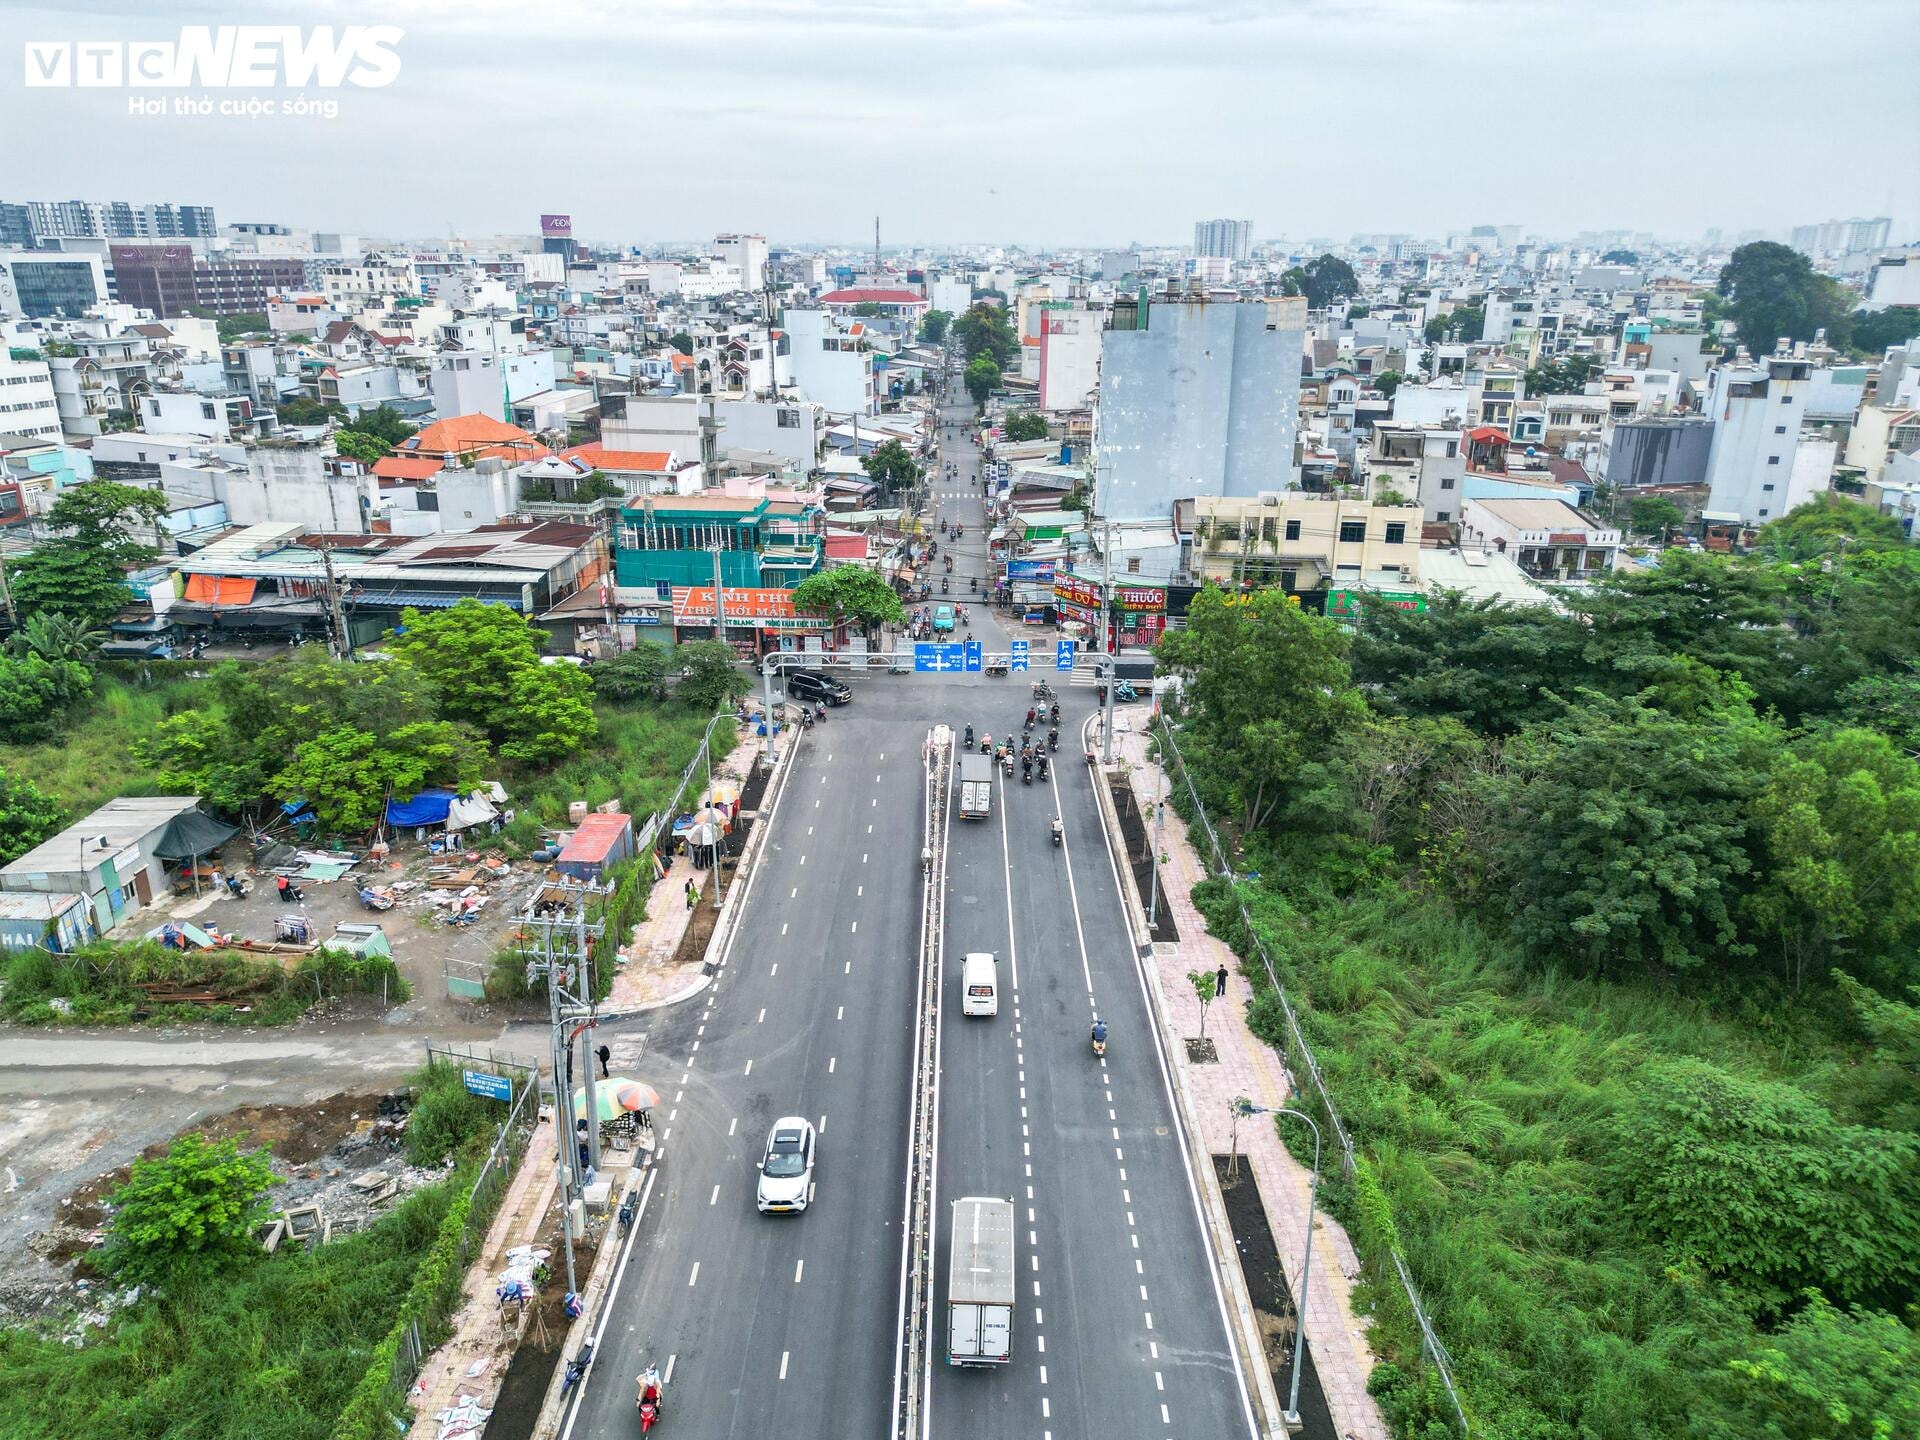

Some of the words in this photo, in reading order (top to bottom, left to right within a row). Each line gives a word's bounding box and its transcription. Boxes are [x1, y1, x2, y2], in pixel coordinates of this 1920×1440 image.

[701, 590, 750, 603] KNH
[1123, 589, 1163, 603] THUỐC
[685, 602, 715, 615] THẾ
[756, 603, 787, 617] MẮT
